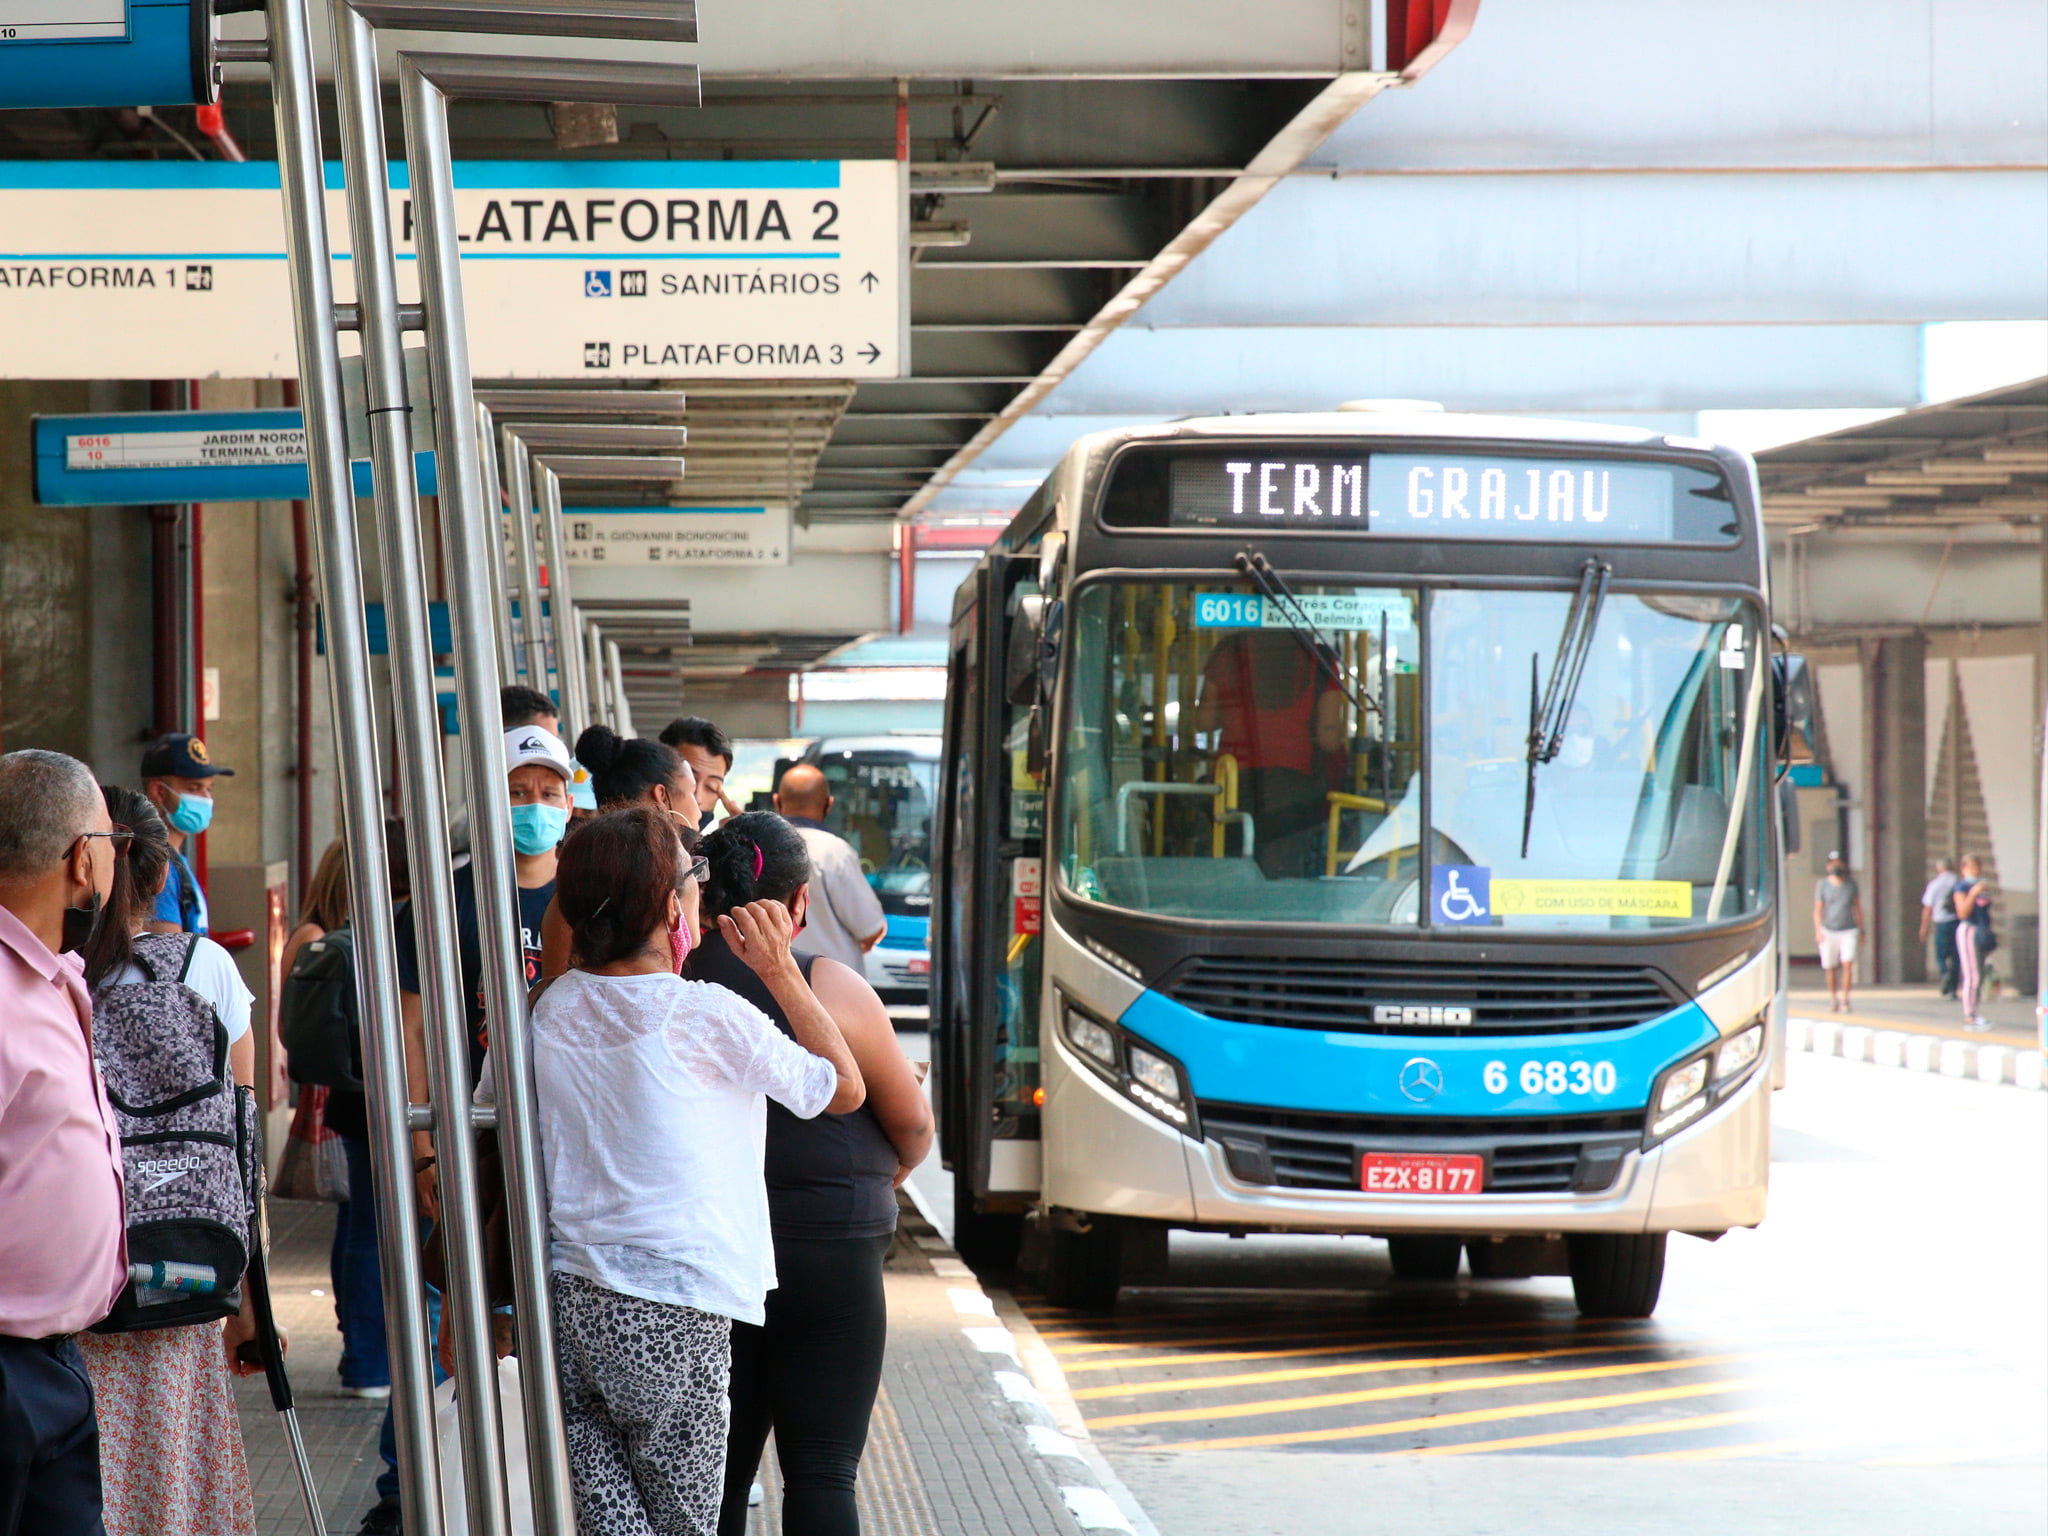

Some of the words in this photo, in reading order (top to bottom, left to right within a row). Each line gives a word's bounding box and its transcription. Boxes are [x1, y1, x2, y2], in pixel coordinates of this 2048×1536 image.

[1, 28, 17, 39] 10
[812, 199, 841, 242] 2
[165, 267, 176, 288] 1
[660, 268, 841, 296] SANITÁRIOS
[622, 343, 821, 366] PLATAFORMA
[829, 343, 844, 366] 3
[77, 436, 111, 448] 6016
[203, 433, 255, 446] JARDIM
[86, 450, 103, 461] 10
[200, 446, 270, 459] TERMINAL
[1407, 466, 1612, 523] GRAJAU
[666, 550, 756, 560] PLATAFORMA
[1200, 598, 1260, 623] 6016
[1296, 598, 1328, 610] Três
[1314, 612, 1363, 626] Belmira
[1535, 896, 1564, 909] COM
[1568, 896, 1594, 909] USO
[1598, 897, 1613, 909] DE
[1617, 895, 1680, 911] MÁSCARA
[1483, 1059, 1509, 1095] 6
[1519, 1060, 1617, 1096] 6830
[138, 1154, 200, 1177] speedo
